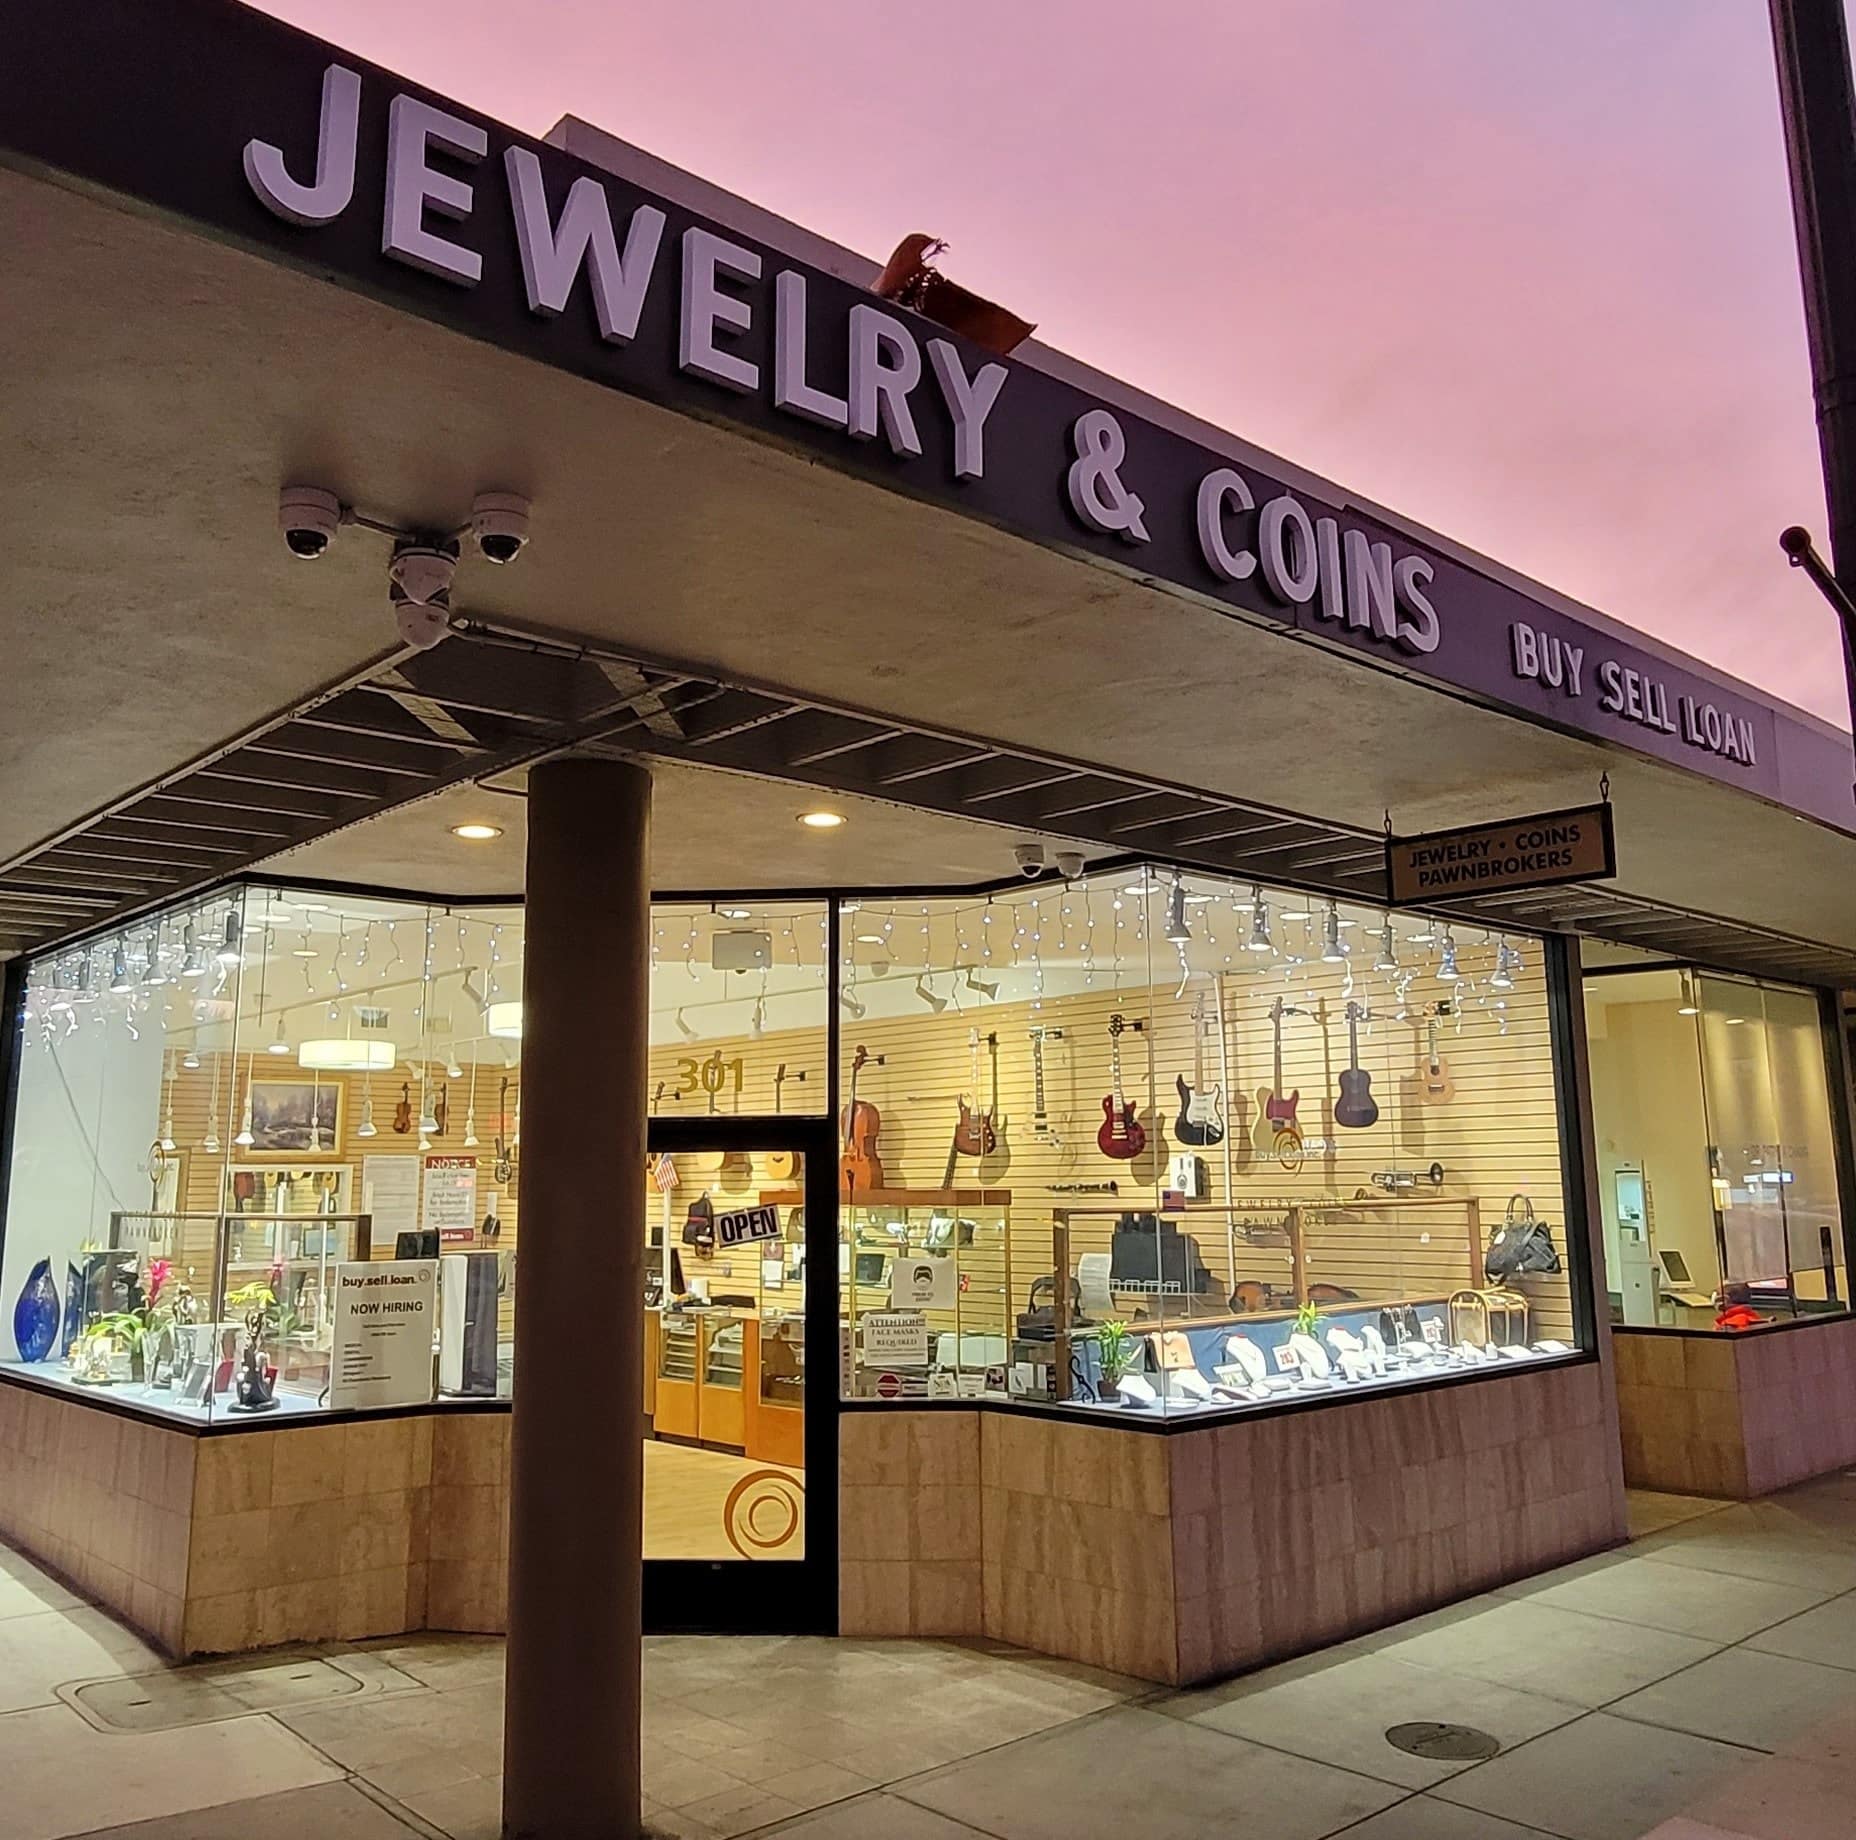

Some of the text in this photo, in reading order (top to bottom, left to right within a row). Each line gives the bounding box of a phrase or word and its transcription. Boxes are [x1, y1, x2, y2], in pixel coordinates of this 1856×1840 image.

[243, 63, 1441, 653] JEWELRY & COINS
[1513, 622, 1756, 765] BUY SELL LOAN
[1410, 825, 1581, 868] JEWELRY COINS
[1419, 848, 1573, 887] PAWNBROKERS
[676, 1058, 744, 1094] 301
[720, 1207, 778, 1243] OPEN
[350, 1301, 423, 1314] NOW HIRING
